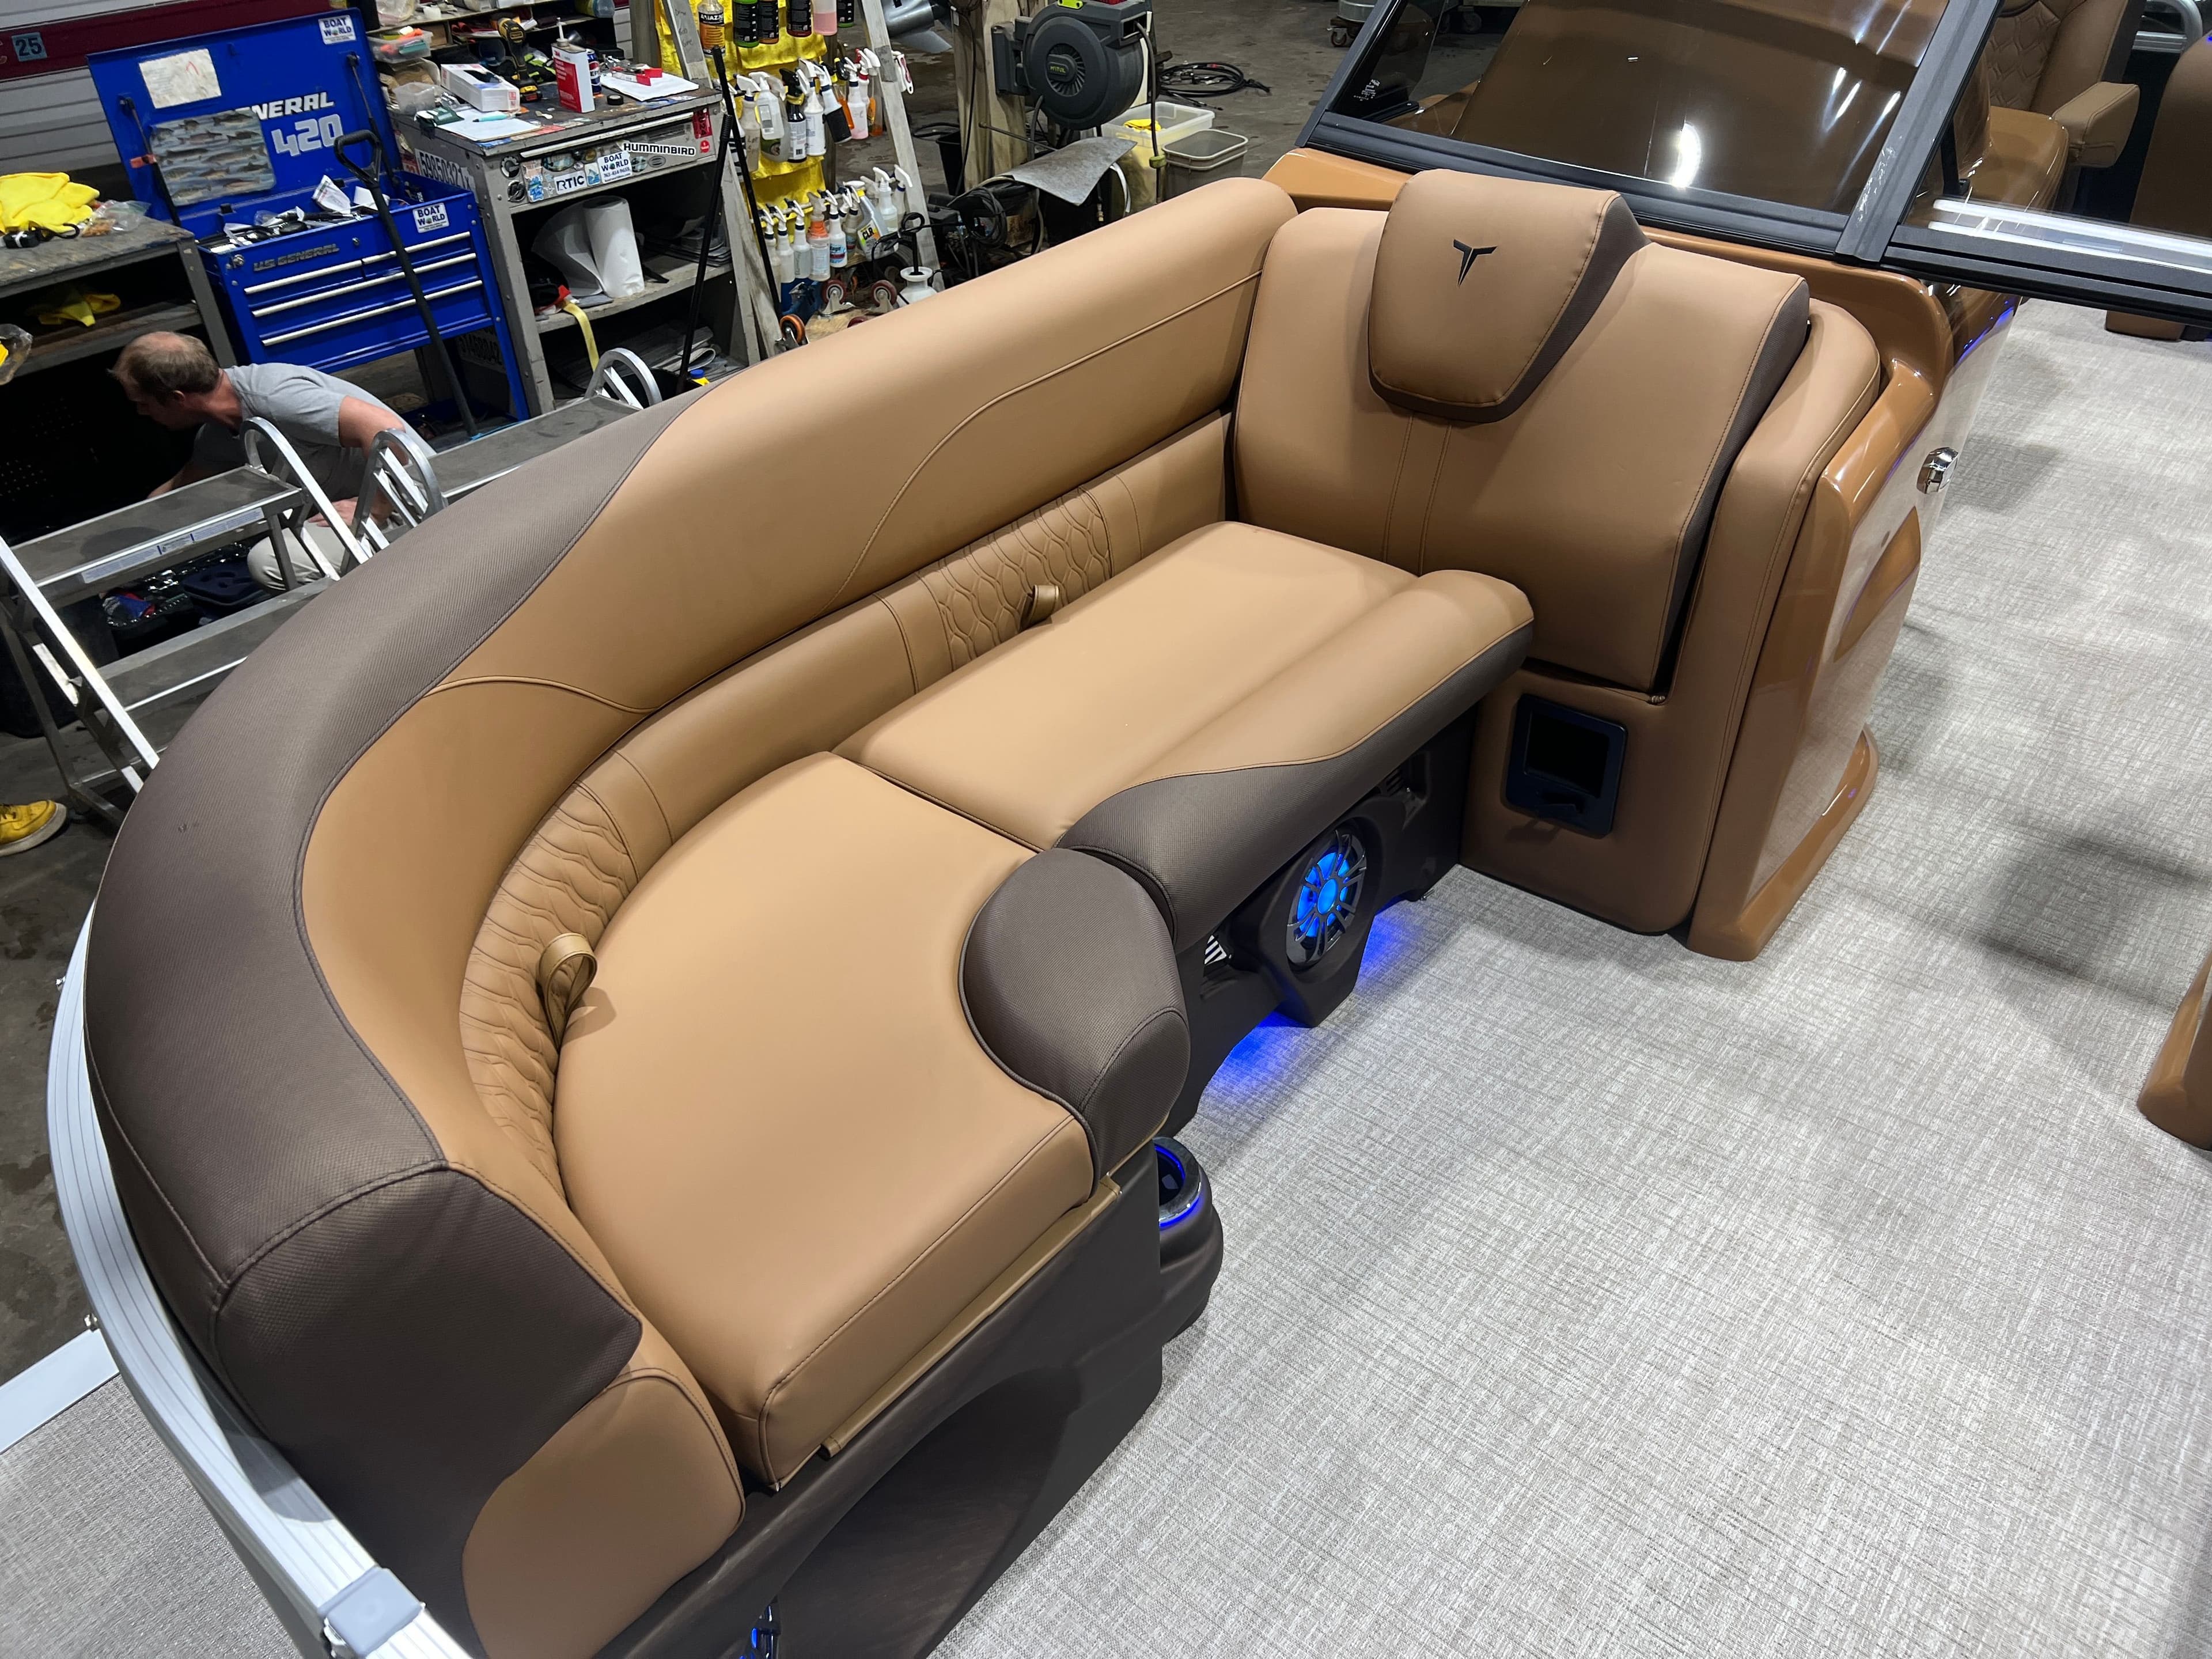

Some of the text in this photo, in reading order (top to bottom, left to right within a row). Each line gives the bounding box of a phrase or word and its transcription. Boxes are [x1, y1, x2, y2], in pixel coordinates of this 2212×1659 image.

[323, 18, 346, 28] BOAT
[16, 37, 42, 56] 25
[271, 114, 343, 156] 420
[624, 143, 695, 155] HUMMINBIRD
[604, 152, 623, 163] BOAT
[556, 175, 585, 191] RTIC
[418, 205, 440, 217] BOAT
[862, 227, 874, 240] CLR
